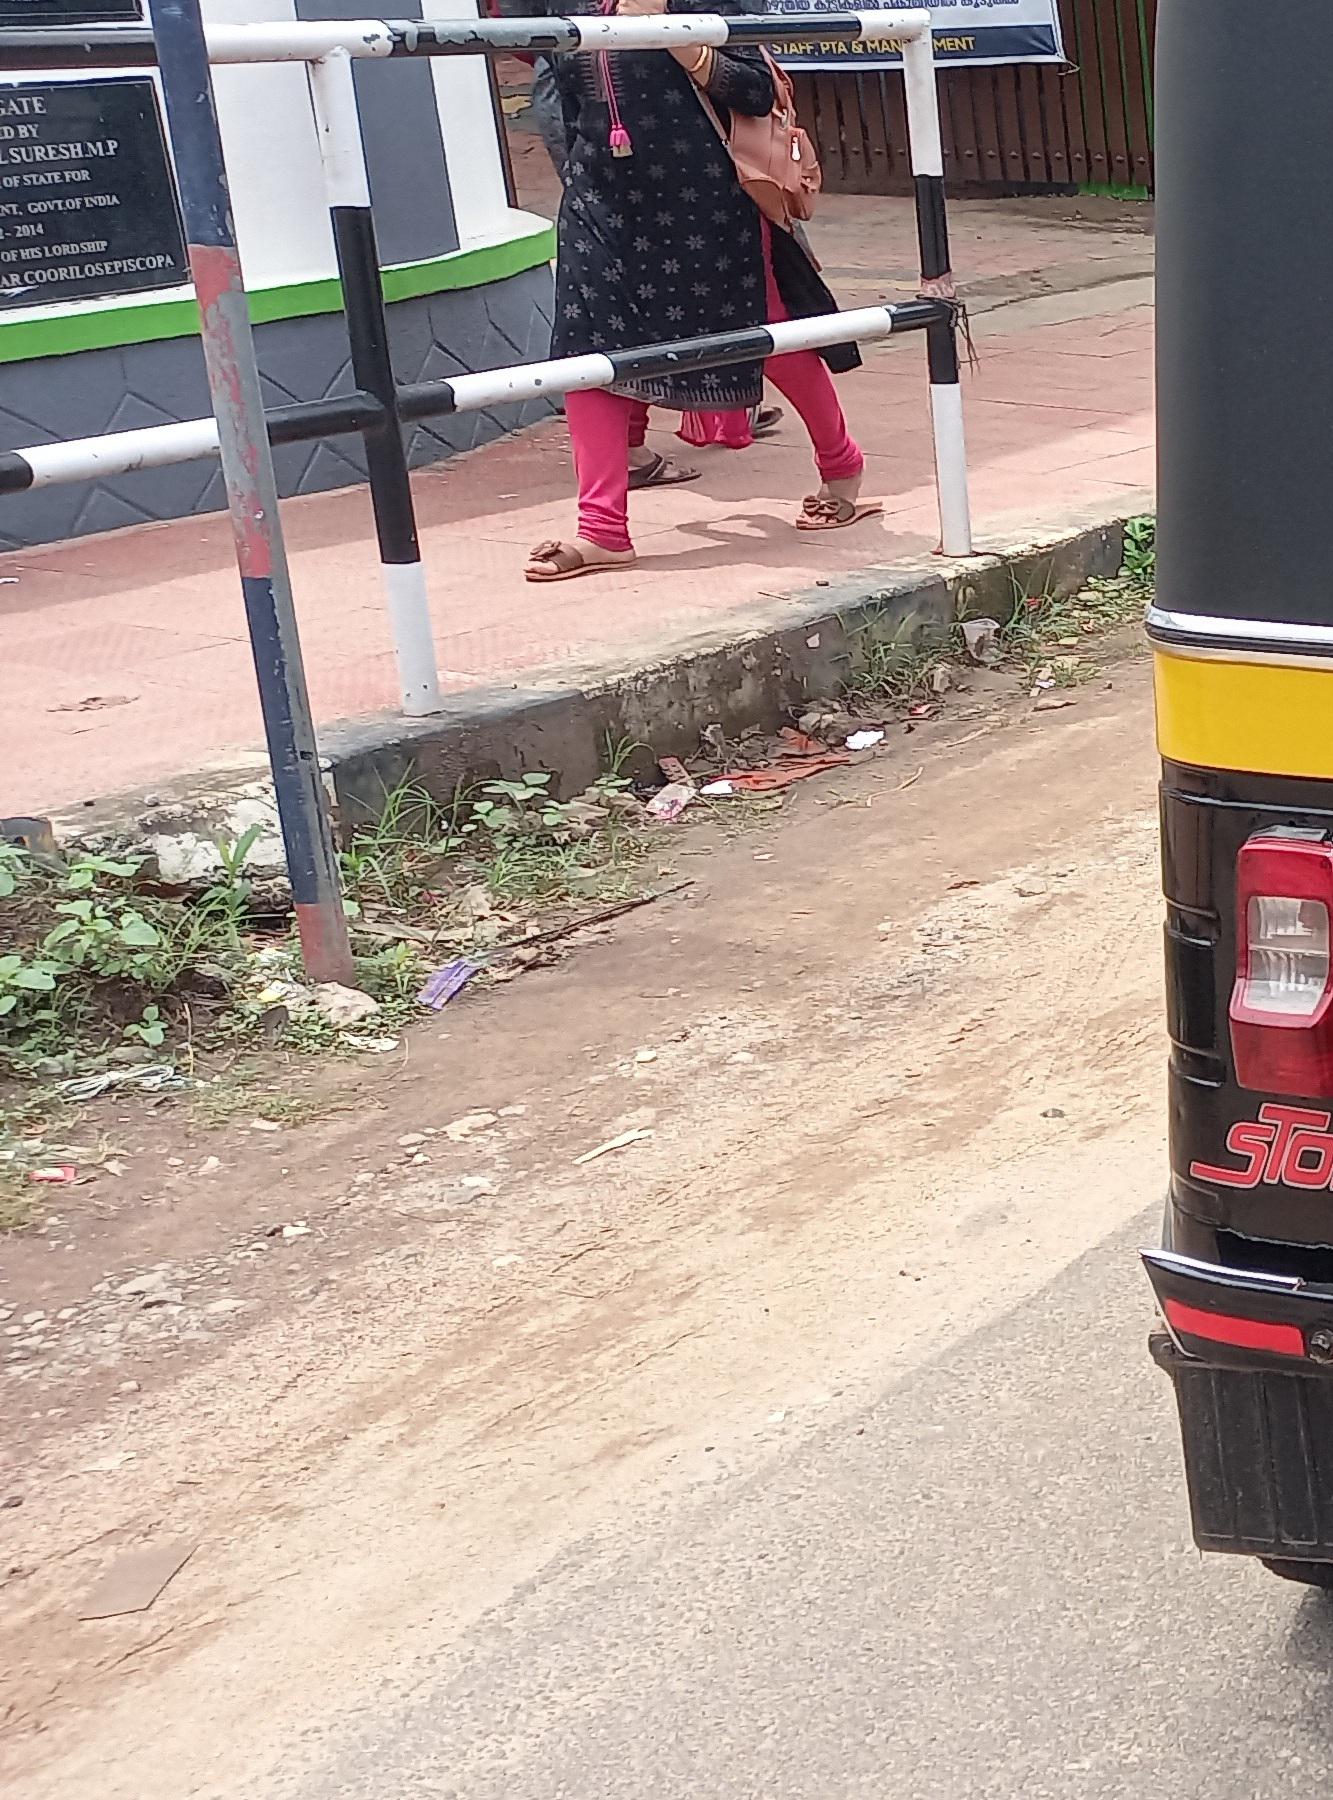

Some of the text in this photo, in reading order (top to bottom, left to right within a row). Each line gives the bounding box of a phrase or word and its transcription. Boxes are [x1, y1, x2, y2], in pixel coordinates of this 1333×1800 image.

[820, 41, 849, 54] PTA
[851, 40, 866, 54] &
[867, 37, 976, 54] MANMENT
[16, 123, 39, 138] BY
[3, 169, 92, 189] OF STATE FOR
[84, 194, 120, 209] INDIA
[14, 223, 44, 238] 2014
[1, 240, 108, 262] OF HIS LORDSHIP
